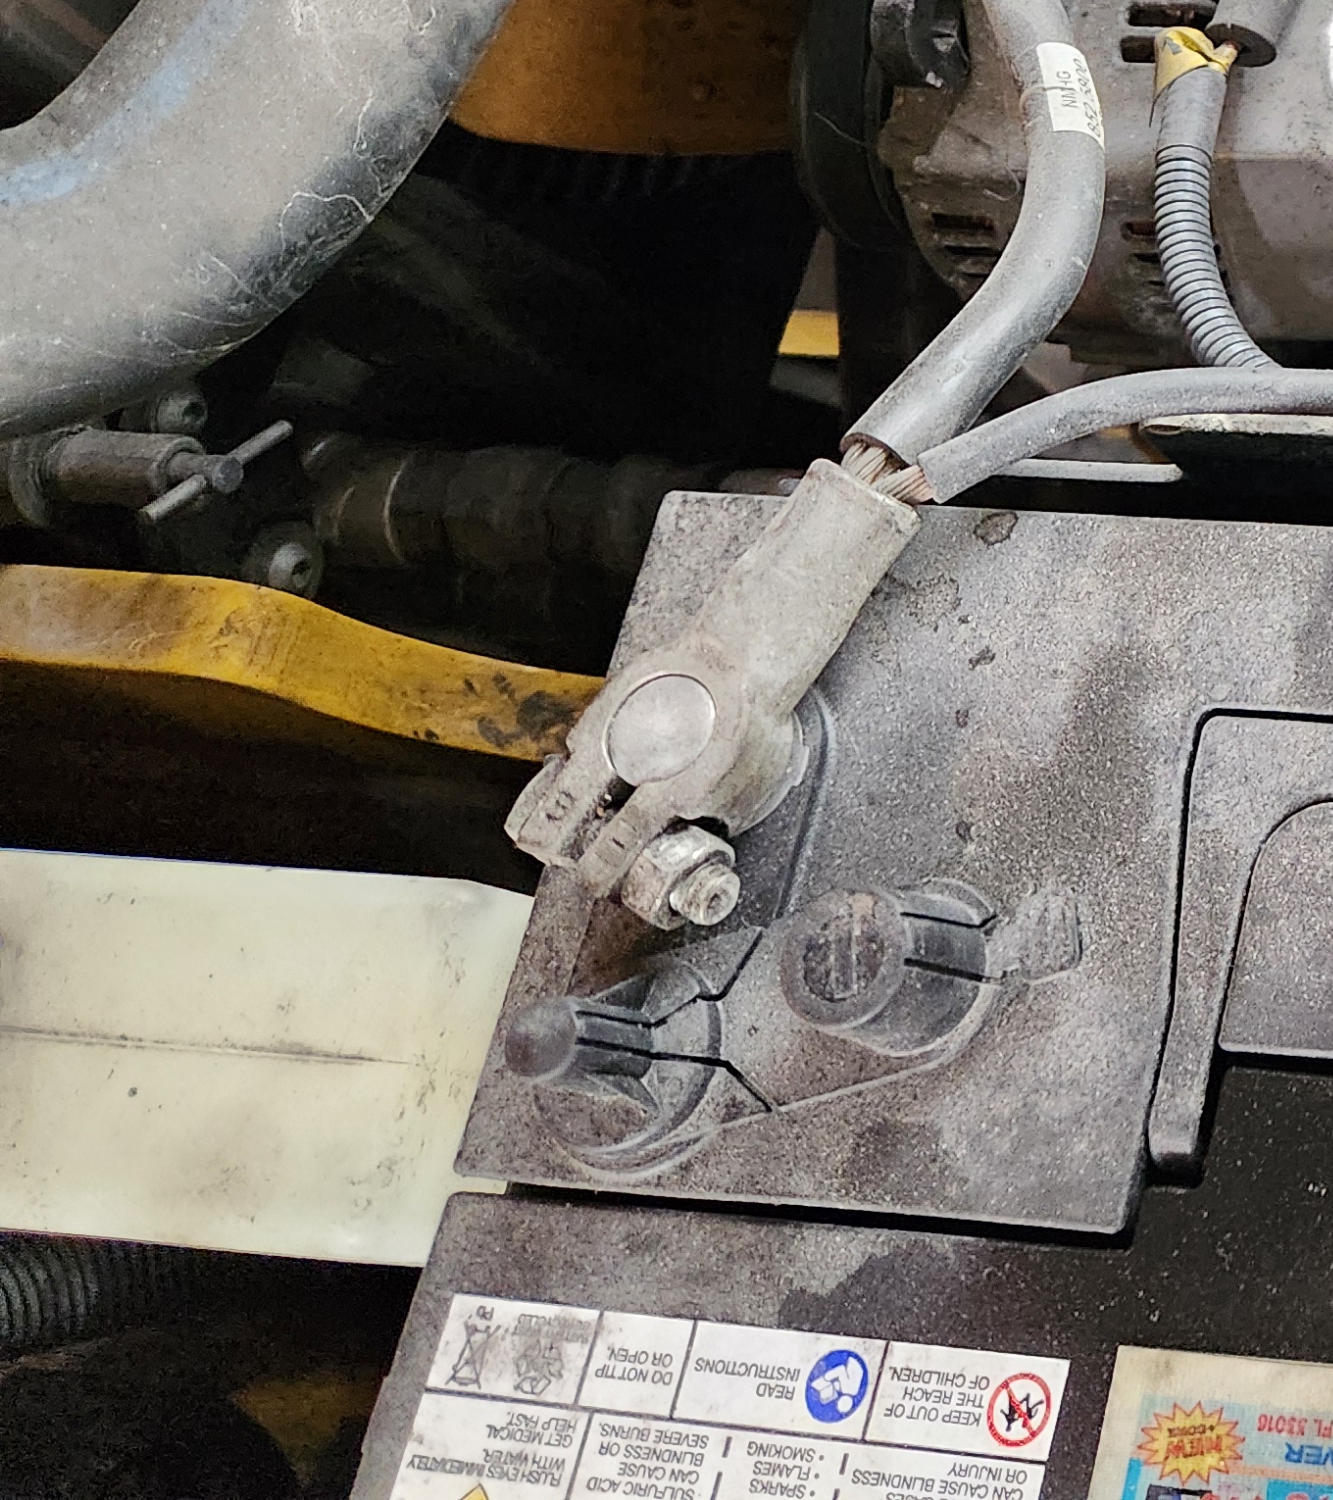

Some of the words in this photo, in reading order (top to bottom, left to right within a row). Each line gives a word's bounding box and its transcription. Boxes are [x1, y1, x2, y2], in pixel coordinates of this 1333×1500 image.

[1056, 71, 1078, 108] NMHG
[607, 1347, 649, 1364] OPEN.
[652, 1353, 673, 1367] OR
[595, 1365, 621, 1378] TIP
[621, 1367, 647, 1382] NOT
[651, 1370, 673, 1385] DO
[694, 1358, 801, 1381] INSTRUCTIONS
[889, 1366, 966, 1387] CHILDREN.
[756, 1383, 796, 1400] READ
[969, 1376, 990, 1390] OF
[902, 1386, 948, 1405] REACH
[957, 1392, 984, 1409] THE
[884, 1403, 906, 1418] OF
[908, 1406, 939, 1422] OUT
[942, 1410, 981, 1426] KEEP
[541, 1417, 578, 1434] HELP
[600, 1423, 650, 1441] BURNS.
[486, 1424, 544, 1445] MEDICAL
[544, 1433, 573, 1448] GET
[653, 1430, 710, 1449] SEVERE
[598, 1442, 621, 1456] OR
[624, 1444, 705, 1467] BLINDNESS
[746, 1441, 816, 1463] SMOKING
[531, 1455, 566, 1472] WITH
[618, 1462, 666, 1481] CAUSE
[753, 1461, 811, 1481] FLAMES
[948, 1462, 1004, 1481] INJURY
[670, 1469, 700, 1485] CAN
[851, 1468, 936, 1492] BLINDNESS
[1005, 1468, 1028, 1484] OR
[586, 1477, 619, 1493] ACID
[622, 1482, 695, 1500] SULFURIC
[749, 1478, 807, 1499] SPARKS
[940, 1480, 989, 1498] CAUSE
[992, 1486, 1023, 1500] CAN
